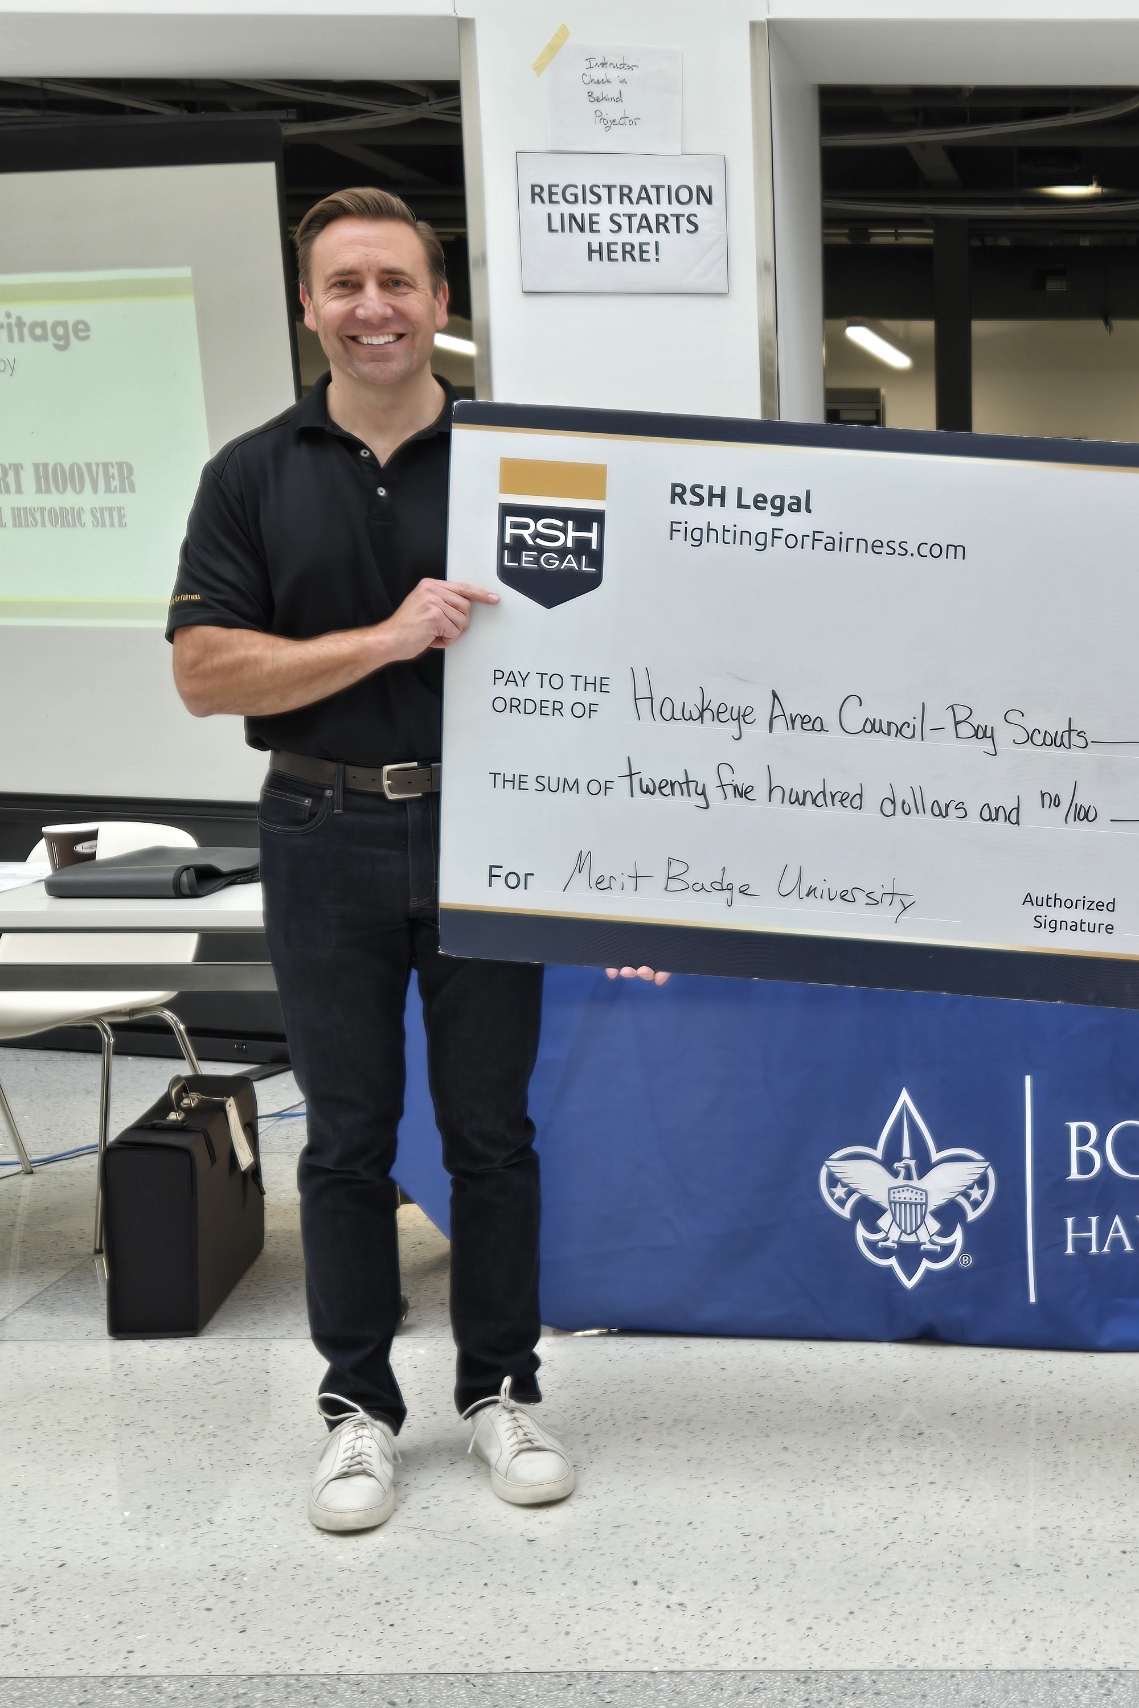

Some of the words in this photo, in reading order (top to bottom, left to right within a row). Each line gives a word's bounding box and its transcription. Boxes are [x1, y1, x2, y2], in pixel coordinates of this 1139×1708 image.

[584, 55, 639, 71] Instructor
[581, 72, 612, 86] Check
[617, 75, 628, 85] in
[587, 89, 624, 103] Behind
[594, 109, 642, 132] Projector
[530, 183, 713, 206] REGISTRATION
[547, 212, 601, 234] LINE
[608, 212, 700, 235] STARTS
[587, 240, 660, 263] HERE!
[0, 311, 92, 351] itage
[32, 460, 137, 495] HOOVER
[669, 482, 727, 508] RSH
[736, 487, 812, 518] Legal
[10, 506, 86, 528] HISTORIC
[91, 505, 127, 528] SITE
[504, 516, 598, 551] RSH
[669, 520, 967, 561] FightingForFairness.com
[504, 550, 596, 572] LEGAL
[493, 669, 531, 688] PAY
[535, 672, 564, 690] TO
[570, 674, 611, 694] THE
[491, 696, 564, 717] ORDER
[570, 701, 600, 719] OF
[630, 666, 757, 741] Hawkeye
[768, 689, 829, 734] Area
[1003, 708, 1090, 750] Scouts
[488, 772, 530, 791] THE
[534, 775, 580, 795] SUM
[586, 778, 615, 797] OF
[617, 755, 711, 810] twenty
[715, 762, 757, 802] five
[767, 764, 864, 812] hundred
[879, 782, 969, 820] dollars
[979, 795, 1021, 827] and
[487, 864, 535, 891] For
[562, 849, 655, 893] Merit
[663, 856, 761, 908] Badge
[776, 862, 917, 925] University
[1021, 891, 1117, 913] Authorized
[1032, 914, 1116, 936] Signature
